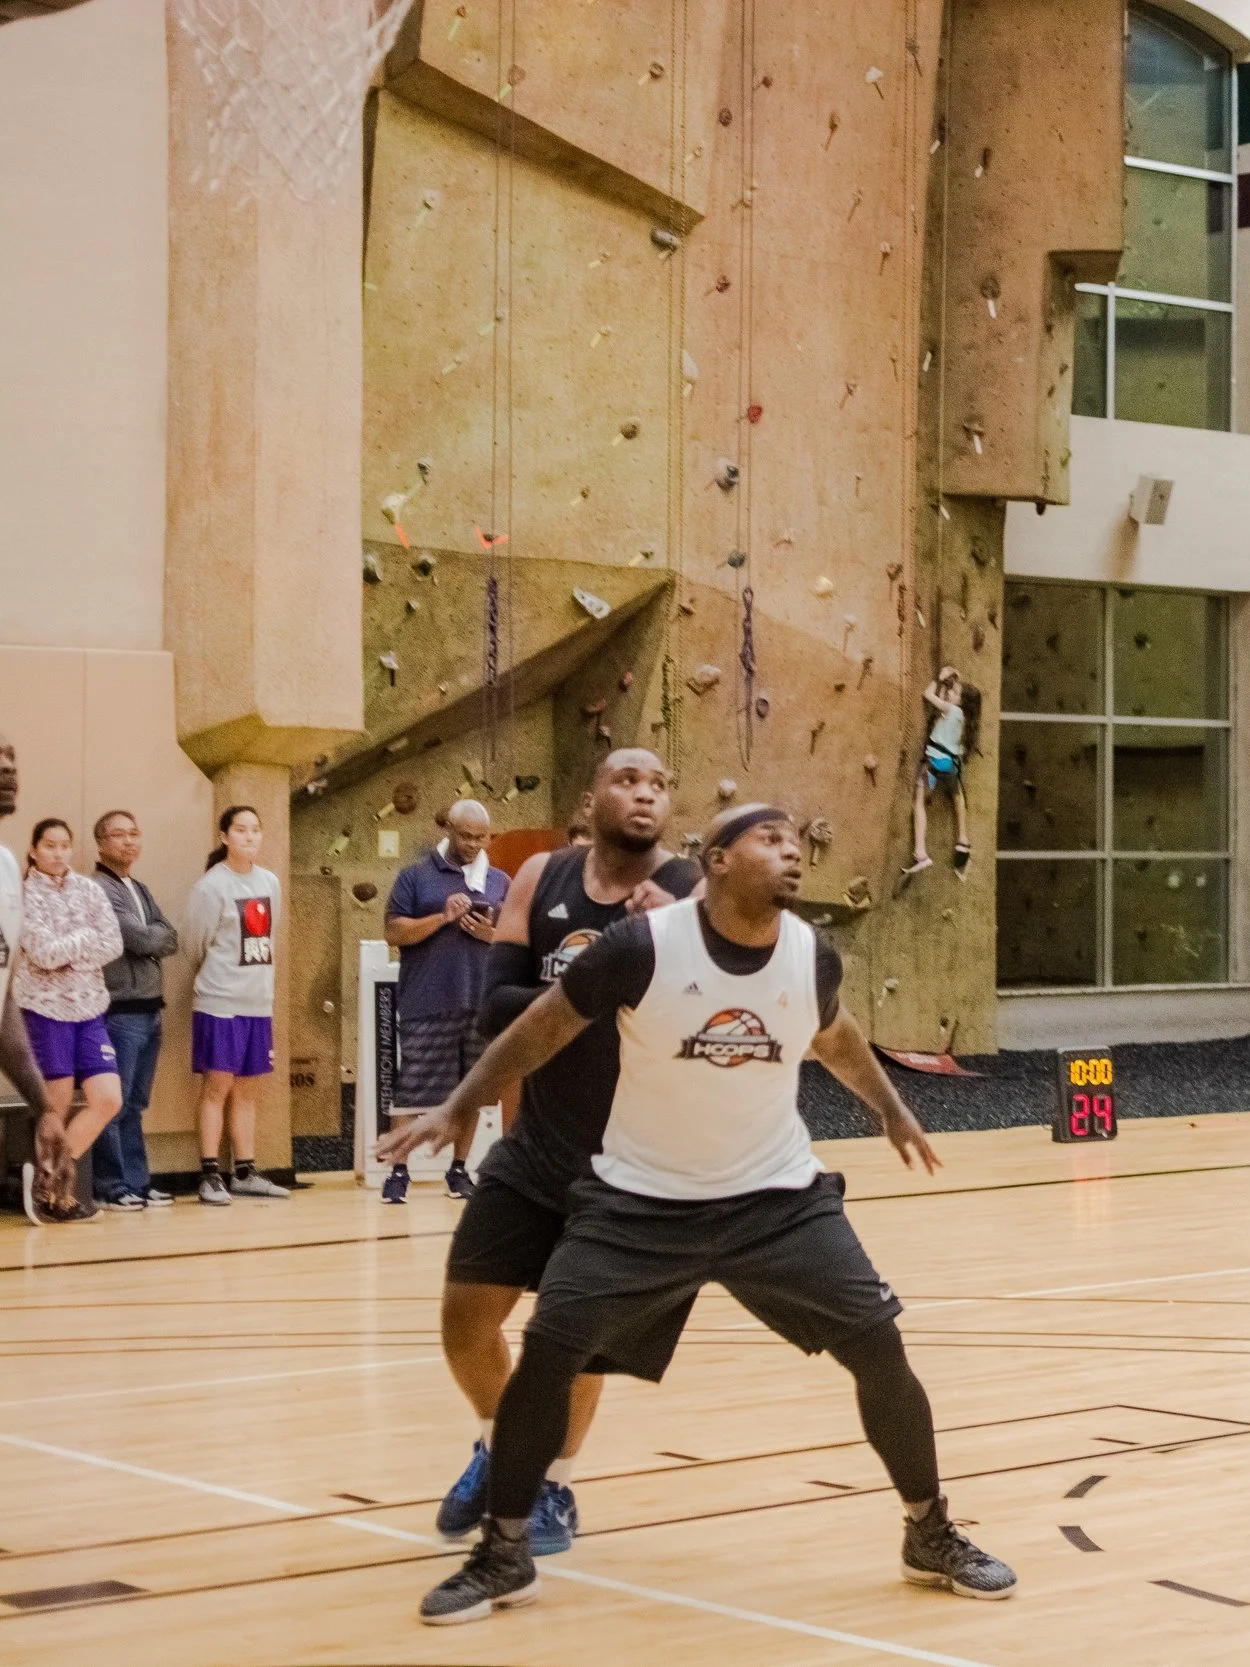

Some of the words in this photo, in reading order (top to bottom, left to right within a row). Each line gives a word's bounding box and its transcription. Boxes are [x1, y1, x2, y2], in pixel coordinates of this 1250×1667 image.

[379, 987, 393, 1048] MEMBERS
[693, 1042, 770, 1059] HOOPS
[1070, 1058, 1113, 1087] 10:00
[1071, 1093, 1112, 1136] 24
